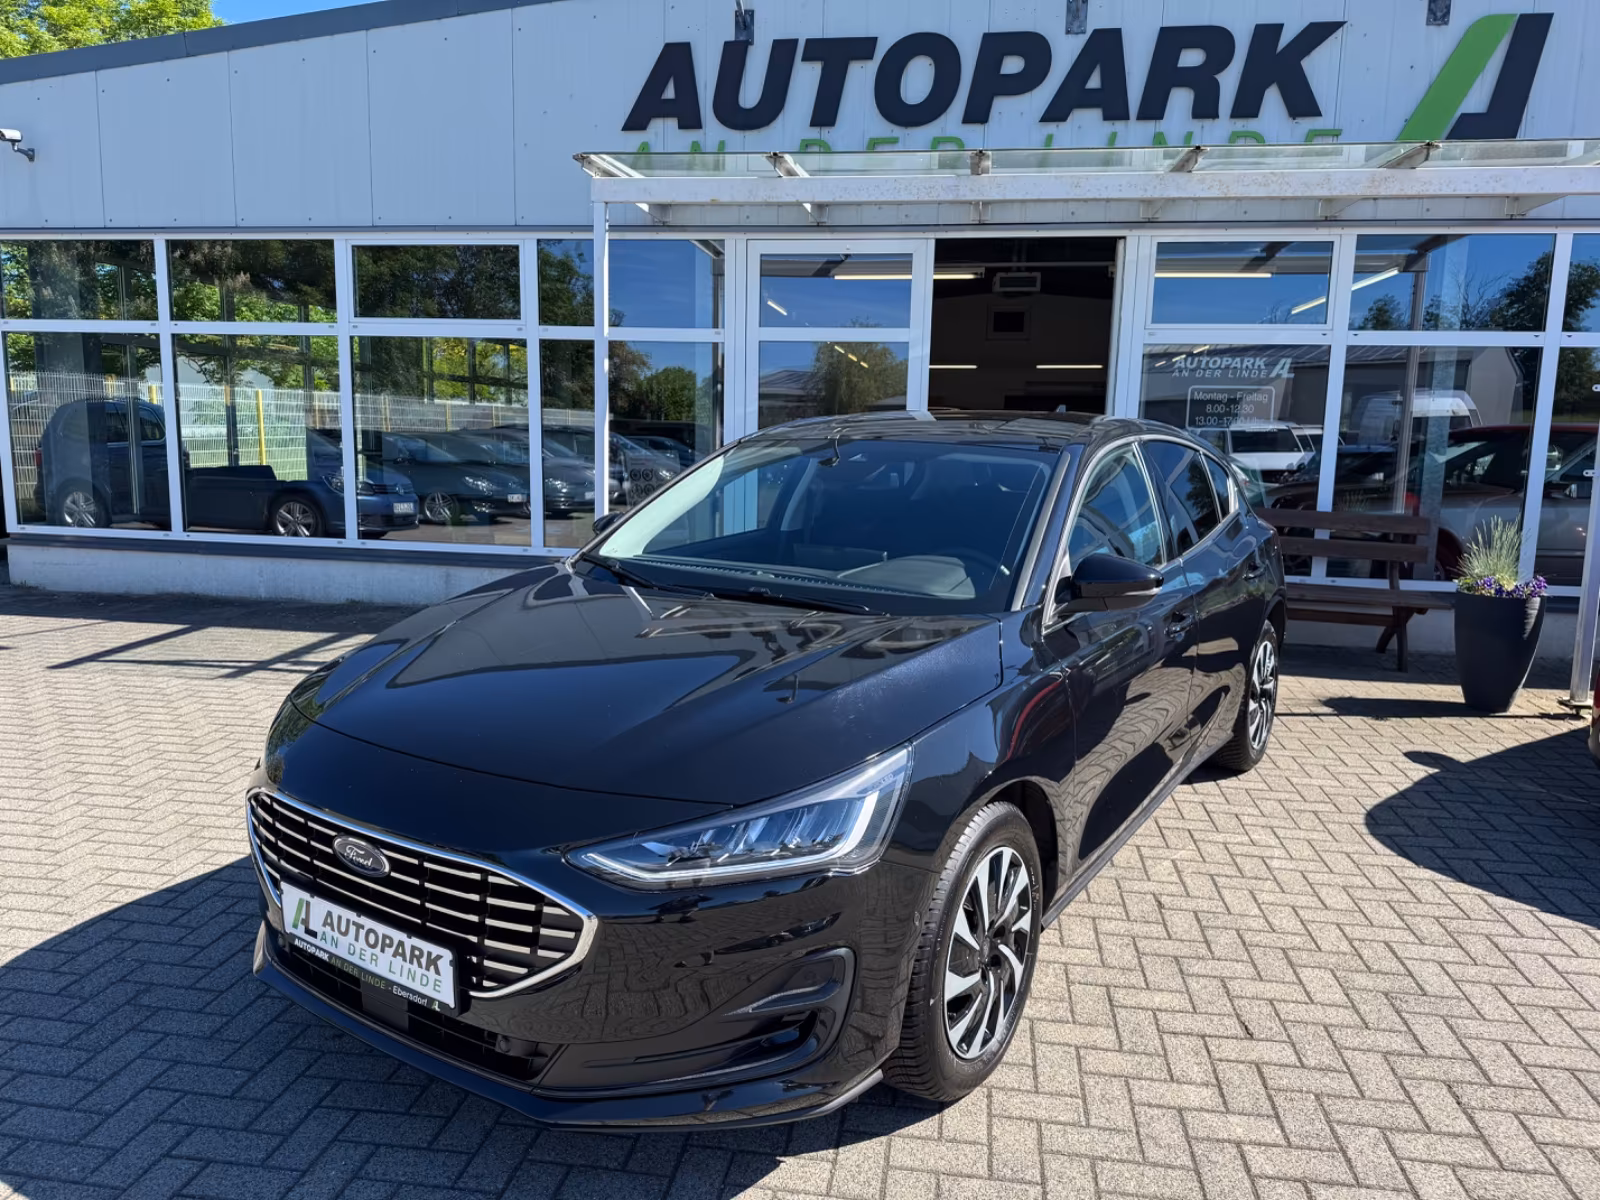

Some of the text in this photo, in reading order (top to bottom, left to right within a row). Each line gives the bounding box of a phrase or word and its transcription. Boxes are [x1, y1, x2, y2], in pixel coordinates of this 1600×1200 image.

[621, 20, 1348, 131] AUTOPARK
[1172, 369, 1268, 378] AN DER LINDE
[1173, 356, 1267, 369] AUTOPARK
[1194, 391, 1228, 402] Montag
[1236, 391, 1268, 403] Freitag
[344, 845, 373, 867] Ford
[320, 930, 442, 994] AN DER LINDE
[321, 909, 444, 977] AUTOPARK
[294, 938, 330, 962] AUTOPARK
[331, 956, 342, 967] AN
[343, 963, 359, 977] DER
[361, 971, 386, 990] LINDE
[392, 985, 428, 1007] Ebersdorf
